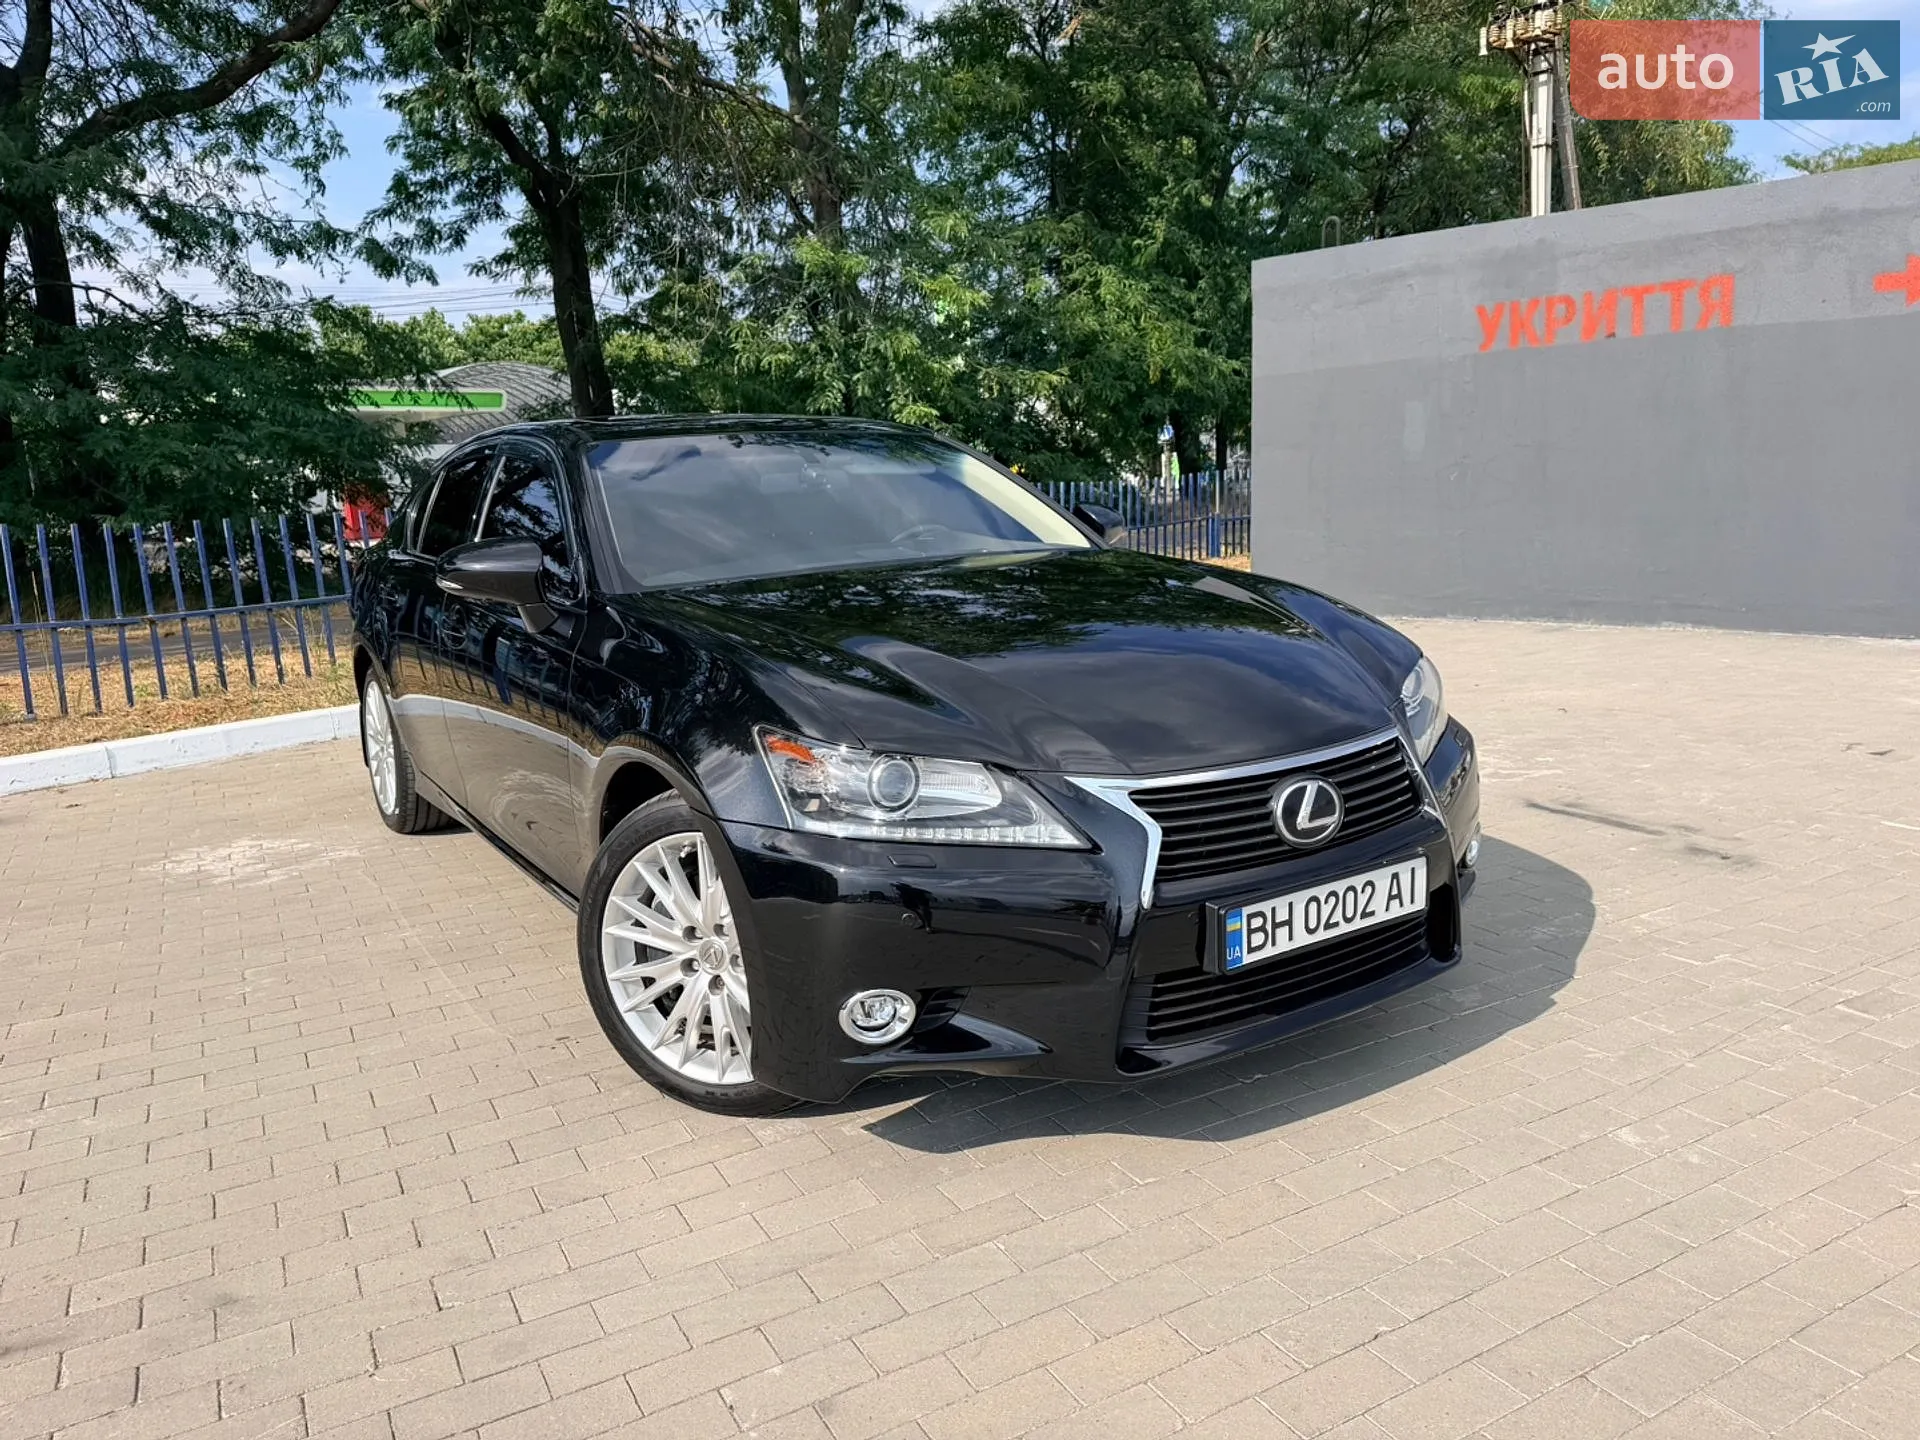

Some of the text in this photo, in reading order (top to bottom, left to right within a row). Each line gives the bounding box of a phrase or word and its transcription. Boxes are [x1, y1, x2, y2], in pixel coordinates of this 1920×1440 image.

[1475, 272, 1735, 353] УКРИТТЯ
[1246, 866, 1416, 955] BH 0202 AI
[1226, 946, 1242, 960] UA
